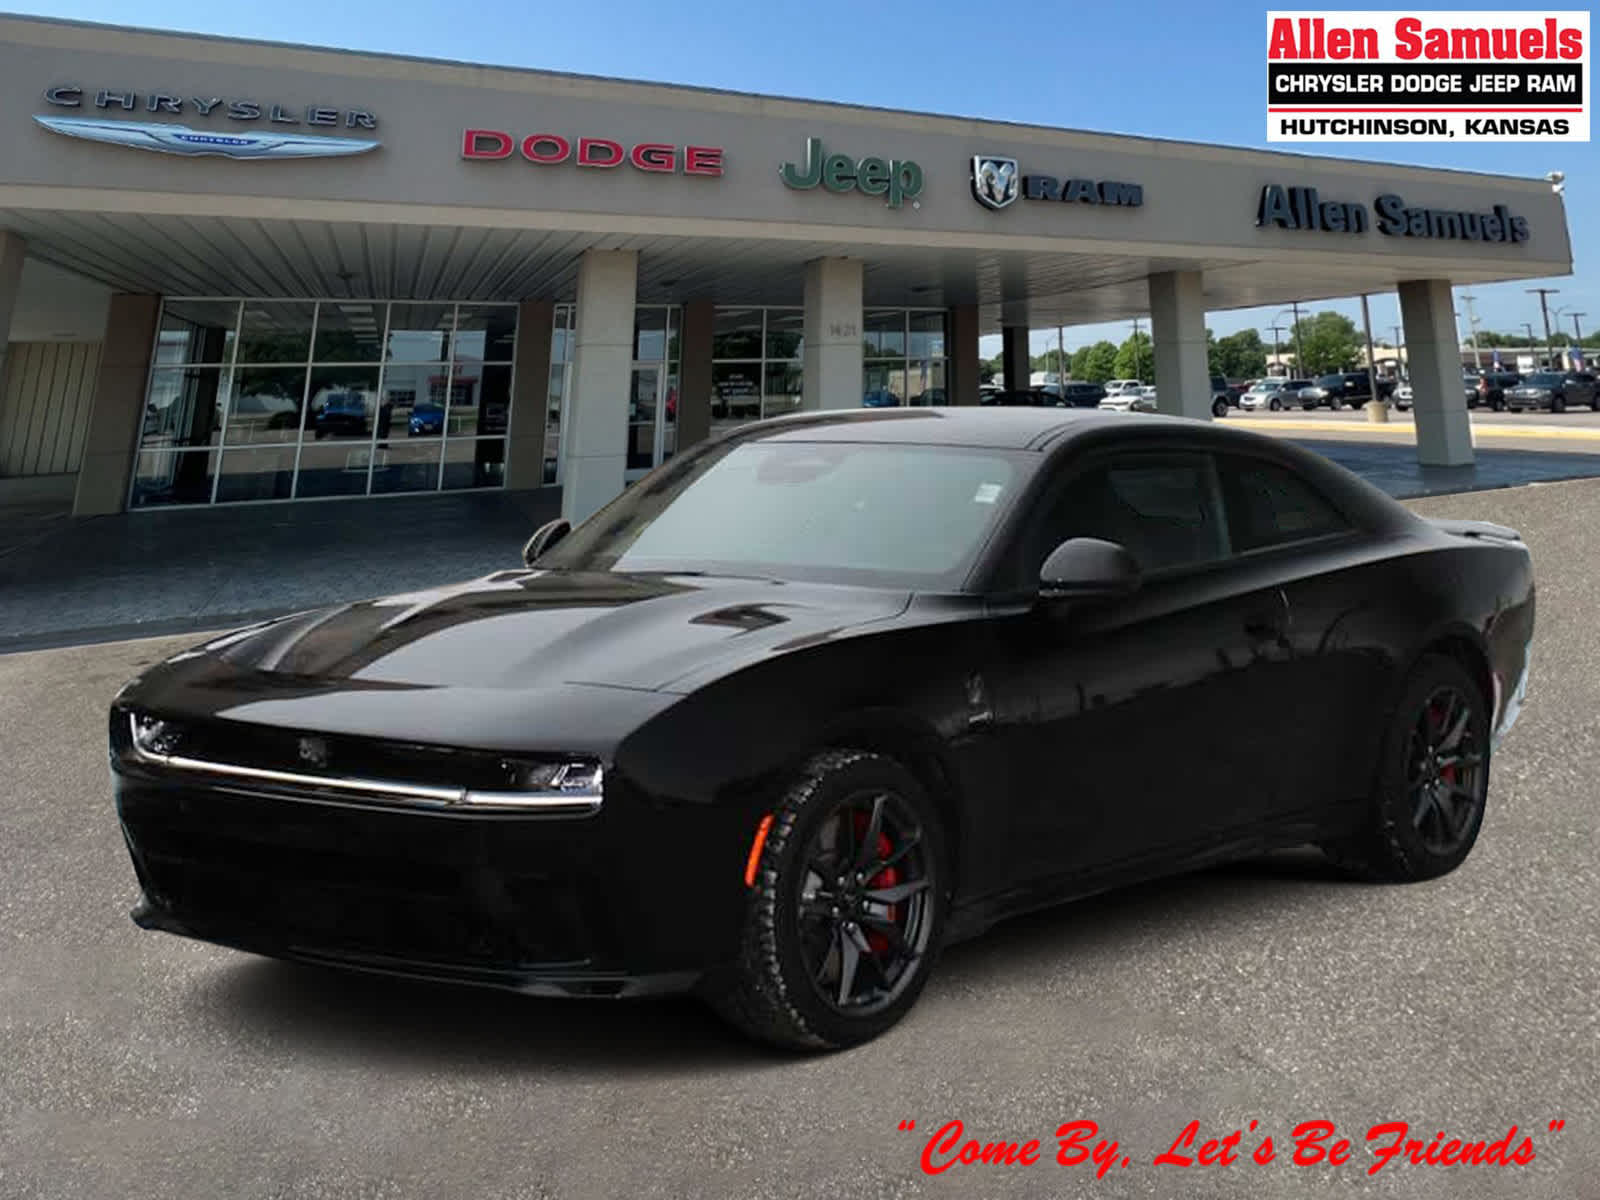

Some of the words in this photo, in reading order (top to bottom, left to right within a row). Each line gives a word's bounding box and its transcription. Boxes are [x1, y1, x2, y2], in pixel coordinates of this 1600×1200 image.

[43, 86, 378, 130] CHRYSLER
[461, 128, 725, 177] DODGE
[778, 137, 923, 210] Jeep
[1023, 175, 1144, 208] RAM
[1256, 184, 1368, 234] Allen
[1374, 193, 1530, 244] Samuels
